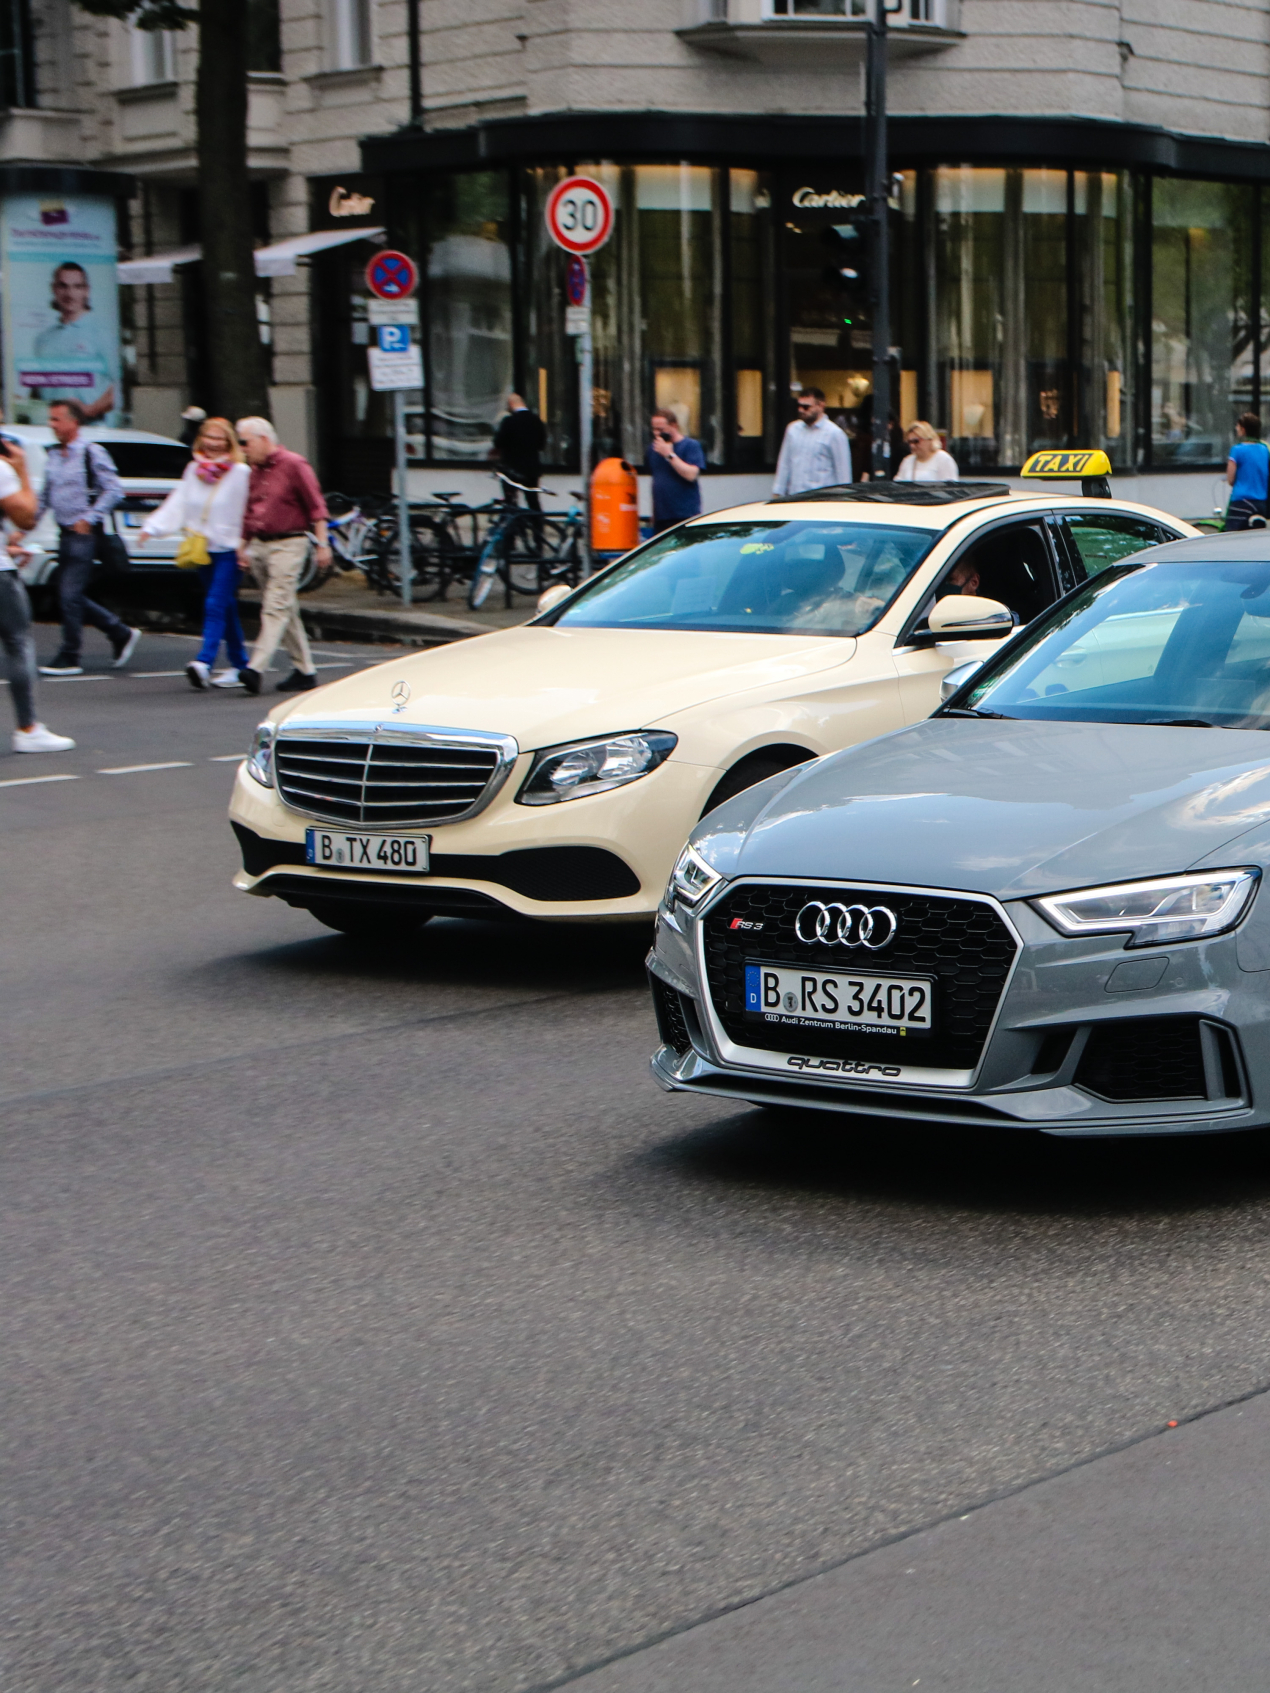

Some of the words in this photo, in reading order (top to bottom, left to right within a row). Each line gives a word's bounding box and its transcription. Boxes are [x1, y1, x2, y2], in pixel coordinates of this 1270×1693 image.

[792, 186, 866, 208] Cartier
[561, 199, 598, 231] 30
[1035, 455, 1090, 472] TAXI
[321, 834, 333, 861] B
[345, 837, 372, 864] TX
[376, 839, 417, 867] 480
[750, 993, 757, 1003] D
[763, 972, 781, 1008] B
[801, 976, 839, 1014] RS
[847, 980, 926, 1023] 3402
[780, 1015, 798, 1025] Audi
[799, 1018, 834, 1029] Zentrum
[834, 1022, 897, 1034] Berlin-Spandau
[787, 1056, 901, 1077] quattro
